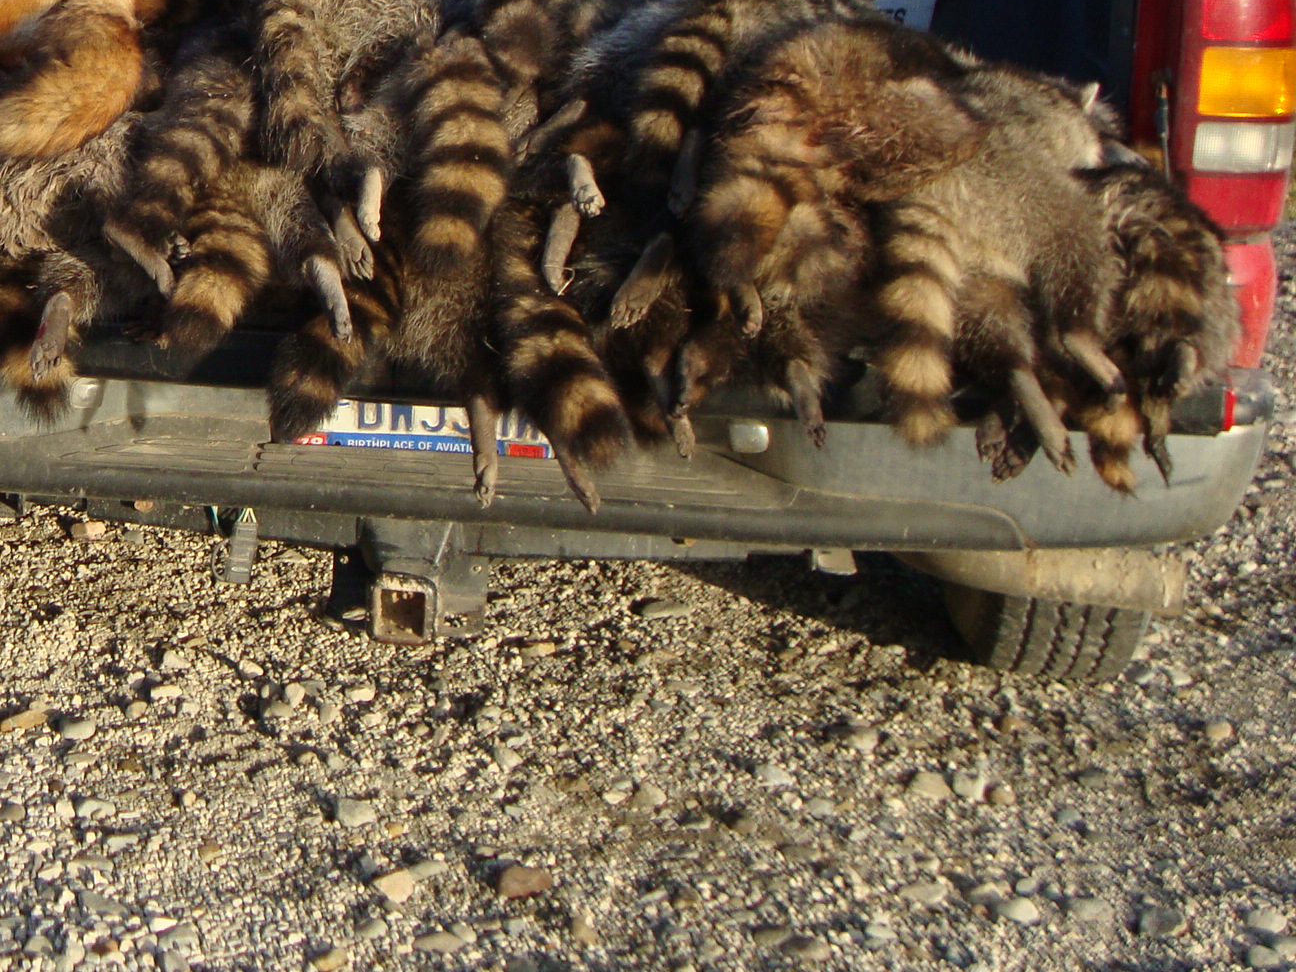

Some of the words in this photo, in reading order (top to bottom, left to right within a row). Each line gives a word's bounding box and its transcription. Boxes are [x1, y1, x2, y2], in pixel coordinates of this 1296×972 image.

[347, 439, 415, 450] BIRTHPLACE
[418, 441, 433, 451] OF
[436, 442, 474, 453] AVIATI
